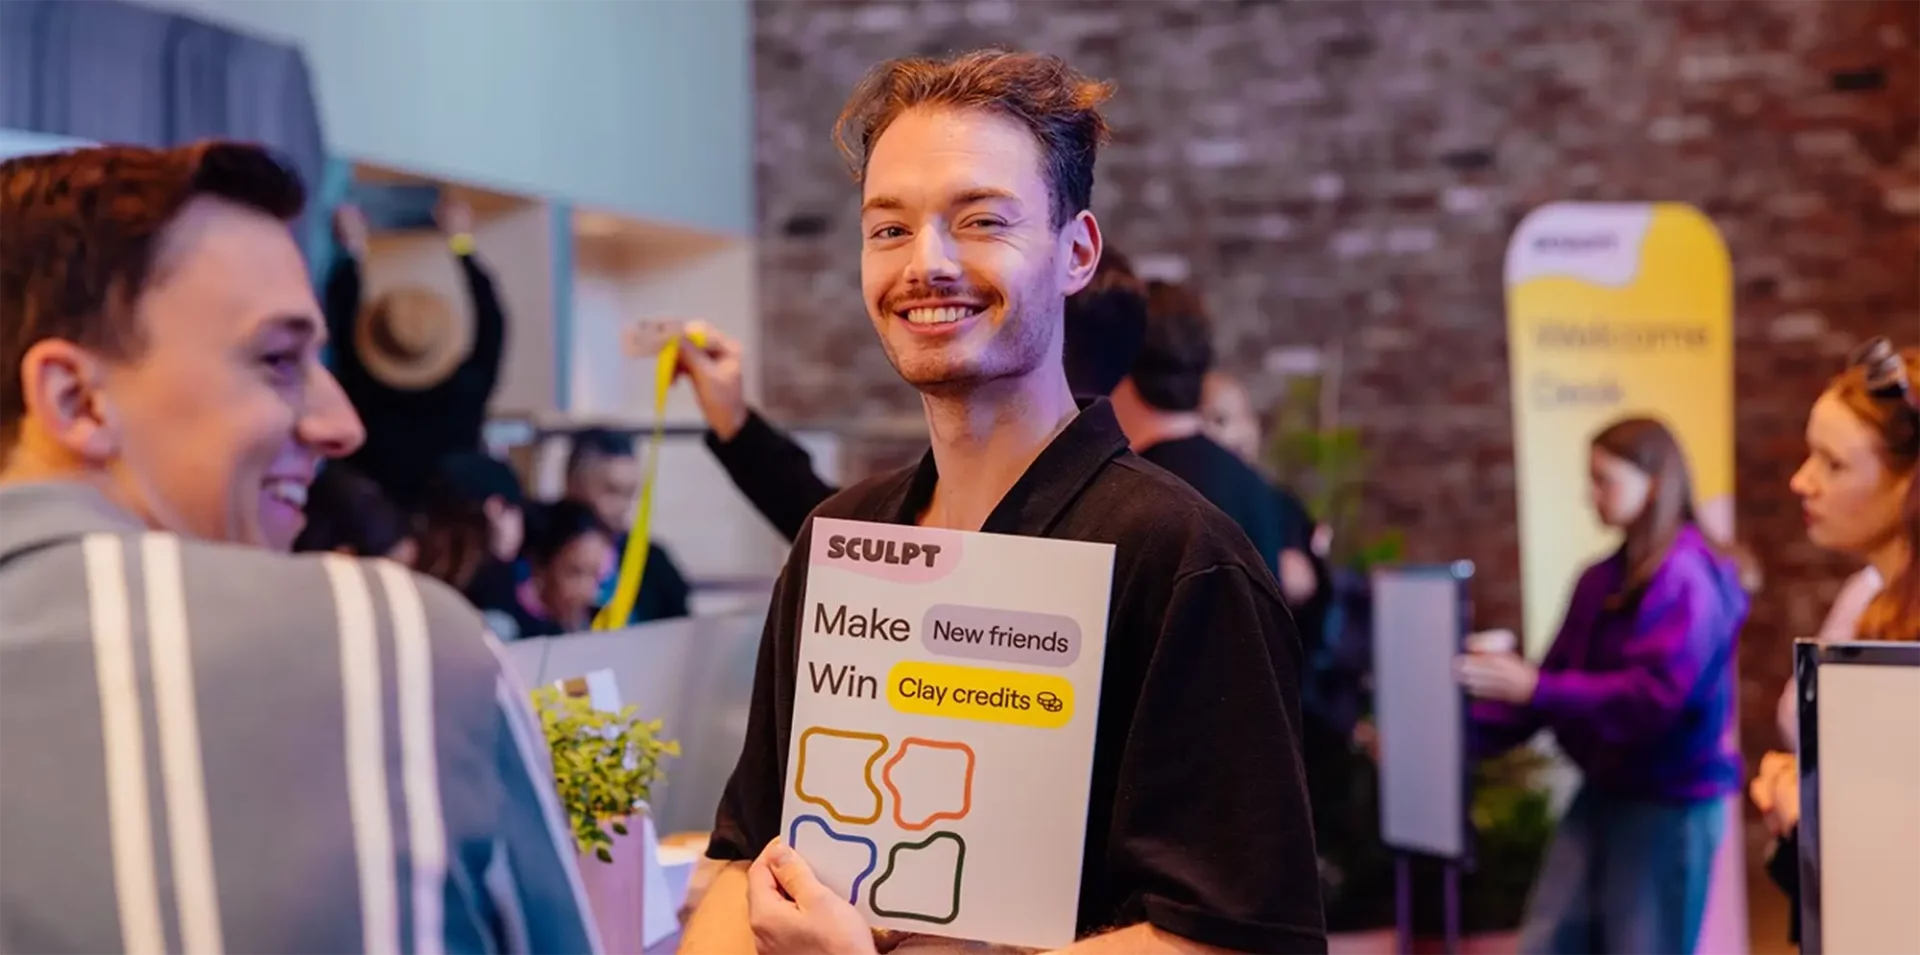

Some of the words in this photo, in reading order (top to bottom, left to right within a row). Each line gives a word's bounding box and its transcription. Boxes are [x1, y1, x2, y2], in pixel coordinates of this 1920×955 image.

[827, 535, 941, 568] SCULPT
[814, 603, 911, 642] Make
[933, 619, 984, 644] New
[989, 625, 1069, 653] friends
[808, 662, 878, 699] Win
[898, 678, 948, 706] Clay
[952, 687, 1031, 711] credits
